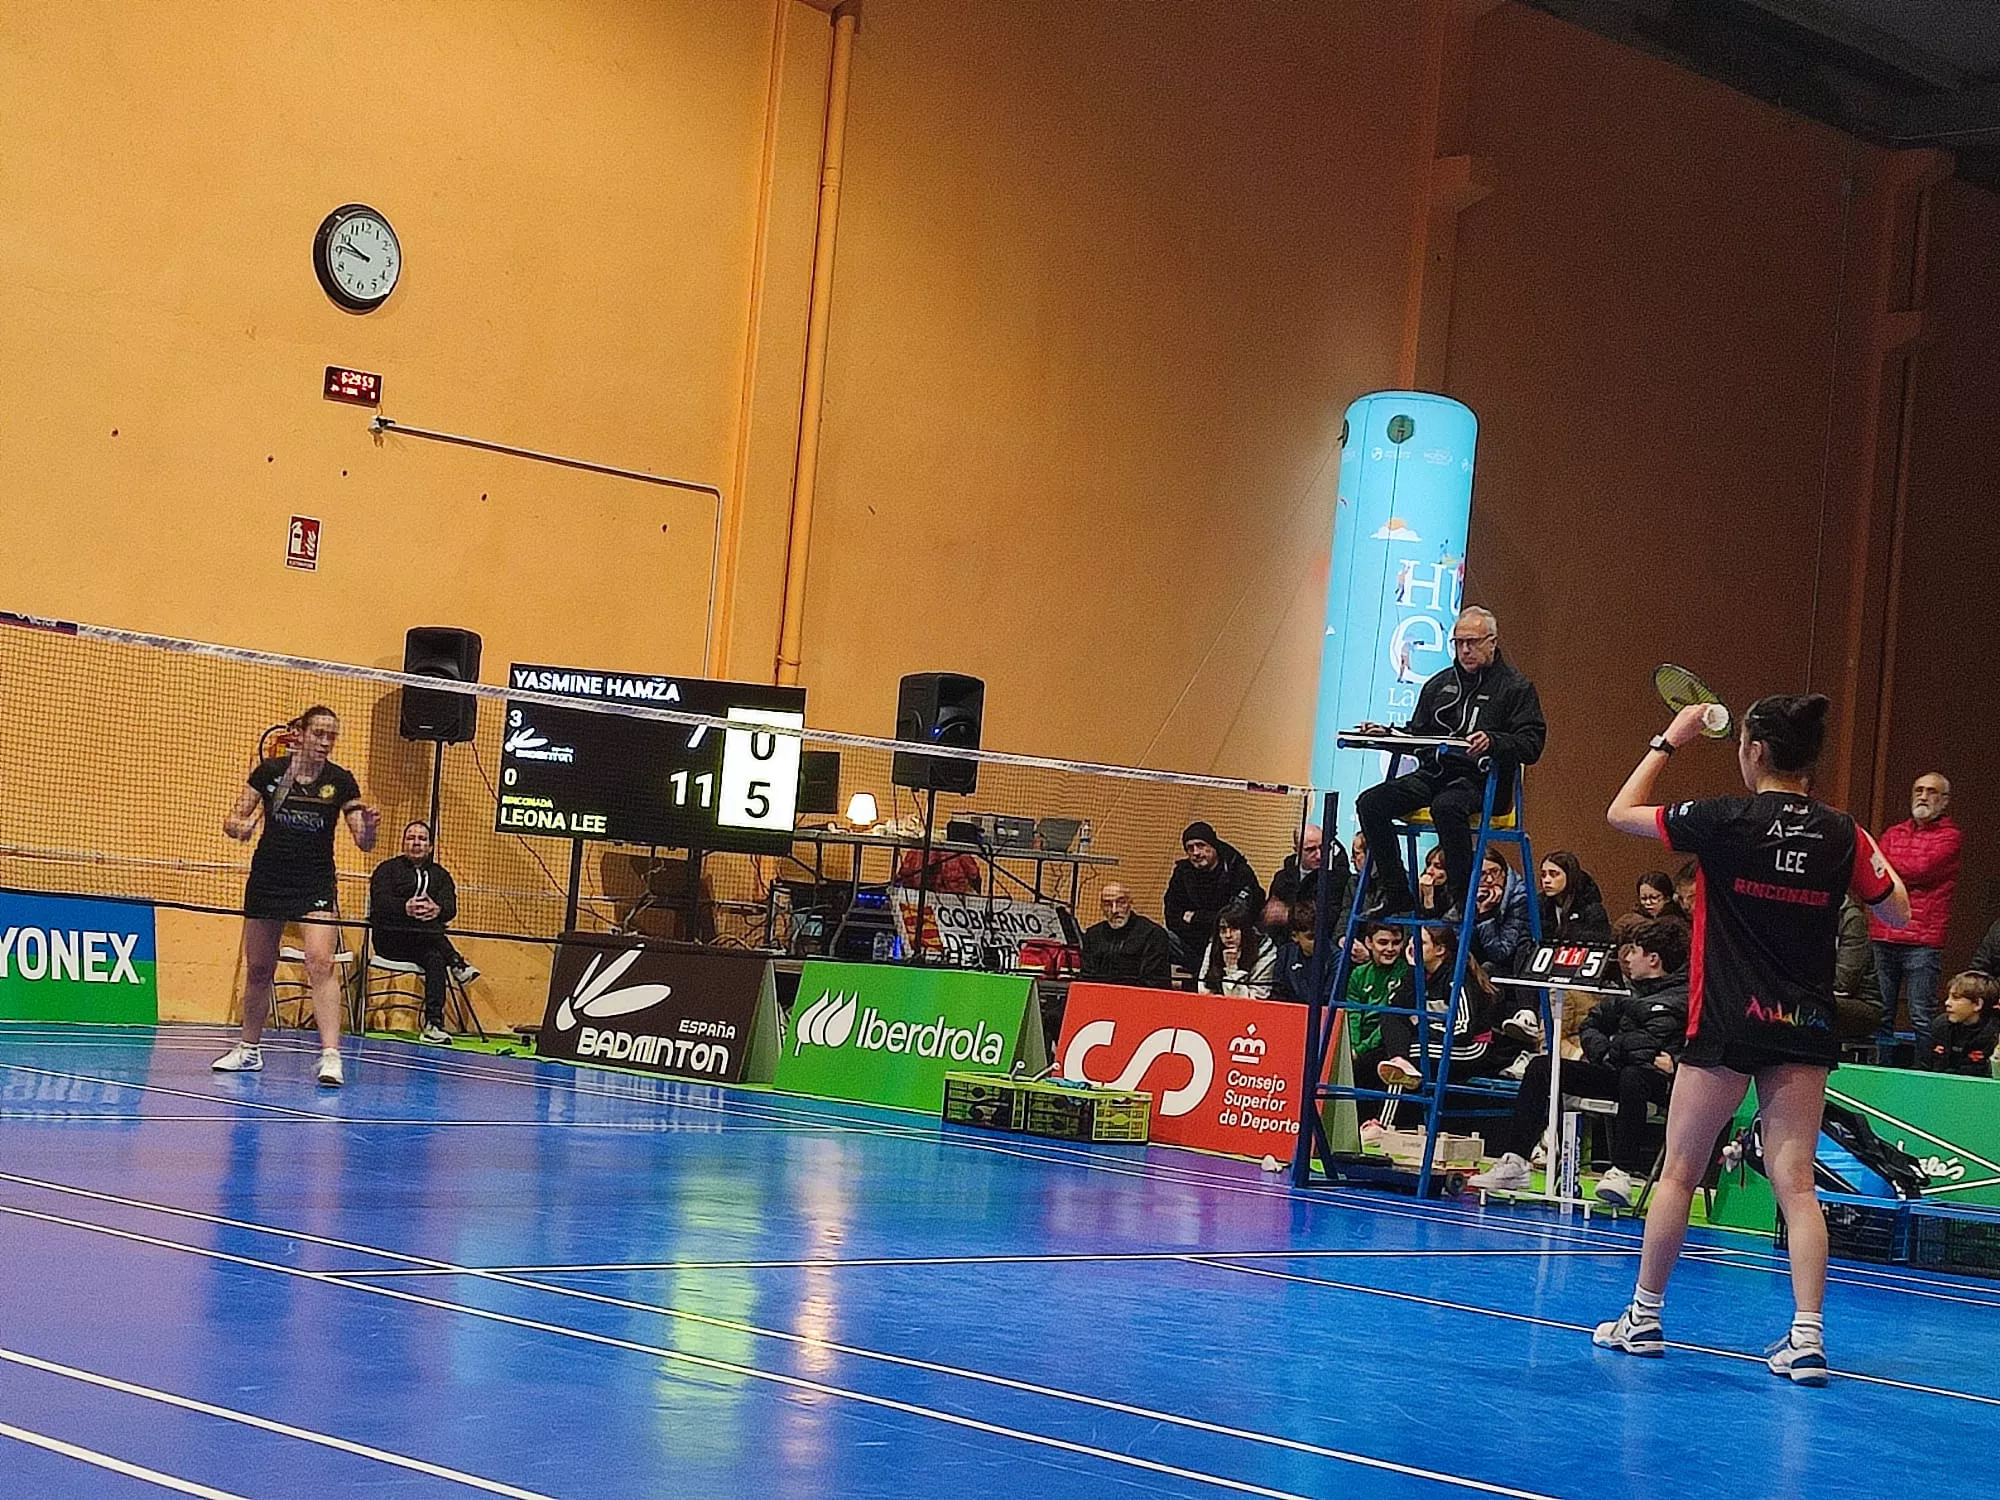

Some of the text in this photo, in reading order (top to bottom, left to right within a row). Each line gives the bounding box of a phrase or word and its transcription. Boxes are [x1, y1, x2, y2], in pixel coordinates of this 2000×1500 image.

[514, 670, 603, 694] YASMINE
[509, 709, 522, 727] 3
[751, 726, 775, 760] 0
[504, 768, 517, 786] 0
[670, 770, 770, 818] 11 5
[501, 807, 607, 833] LEONA LEE
[1775, 850, 1807, 874] LEE
[0, 927, 140, 984] YONEX
[1532, 948, 1553, 972] 0
[1581, 952, 1604, 976] 5
[856, 1007, 1004, 1065] Iberdrola
[576, 1027, 729, 1075] BADMINTON
[1228, 1069, 1285, 1095] Consejo
[1224, 1090, 1286, 1114] Superior
[1219, 1110, 1238, 1127] de
